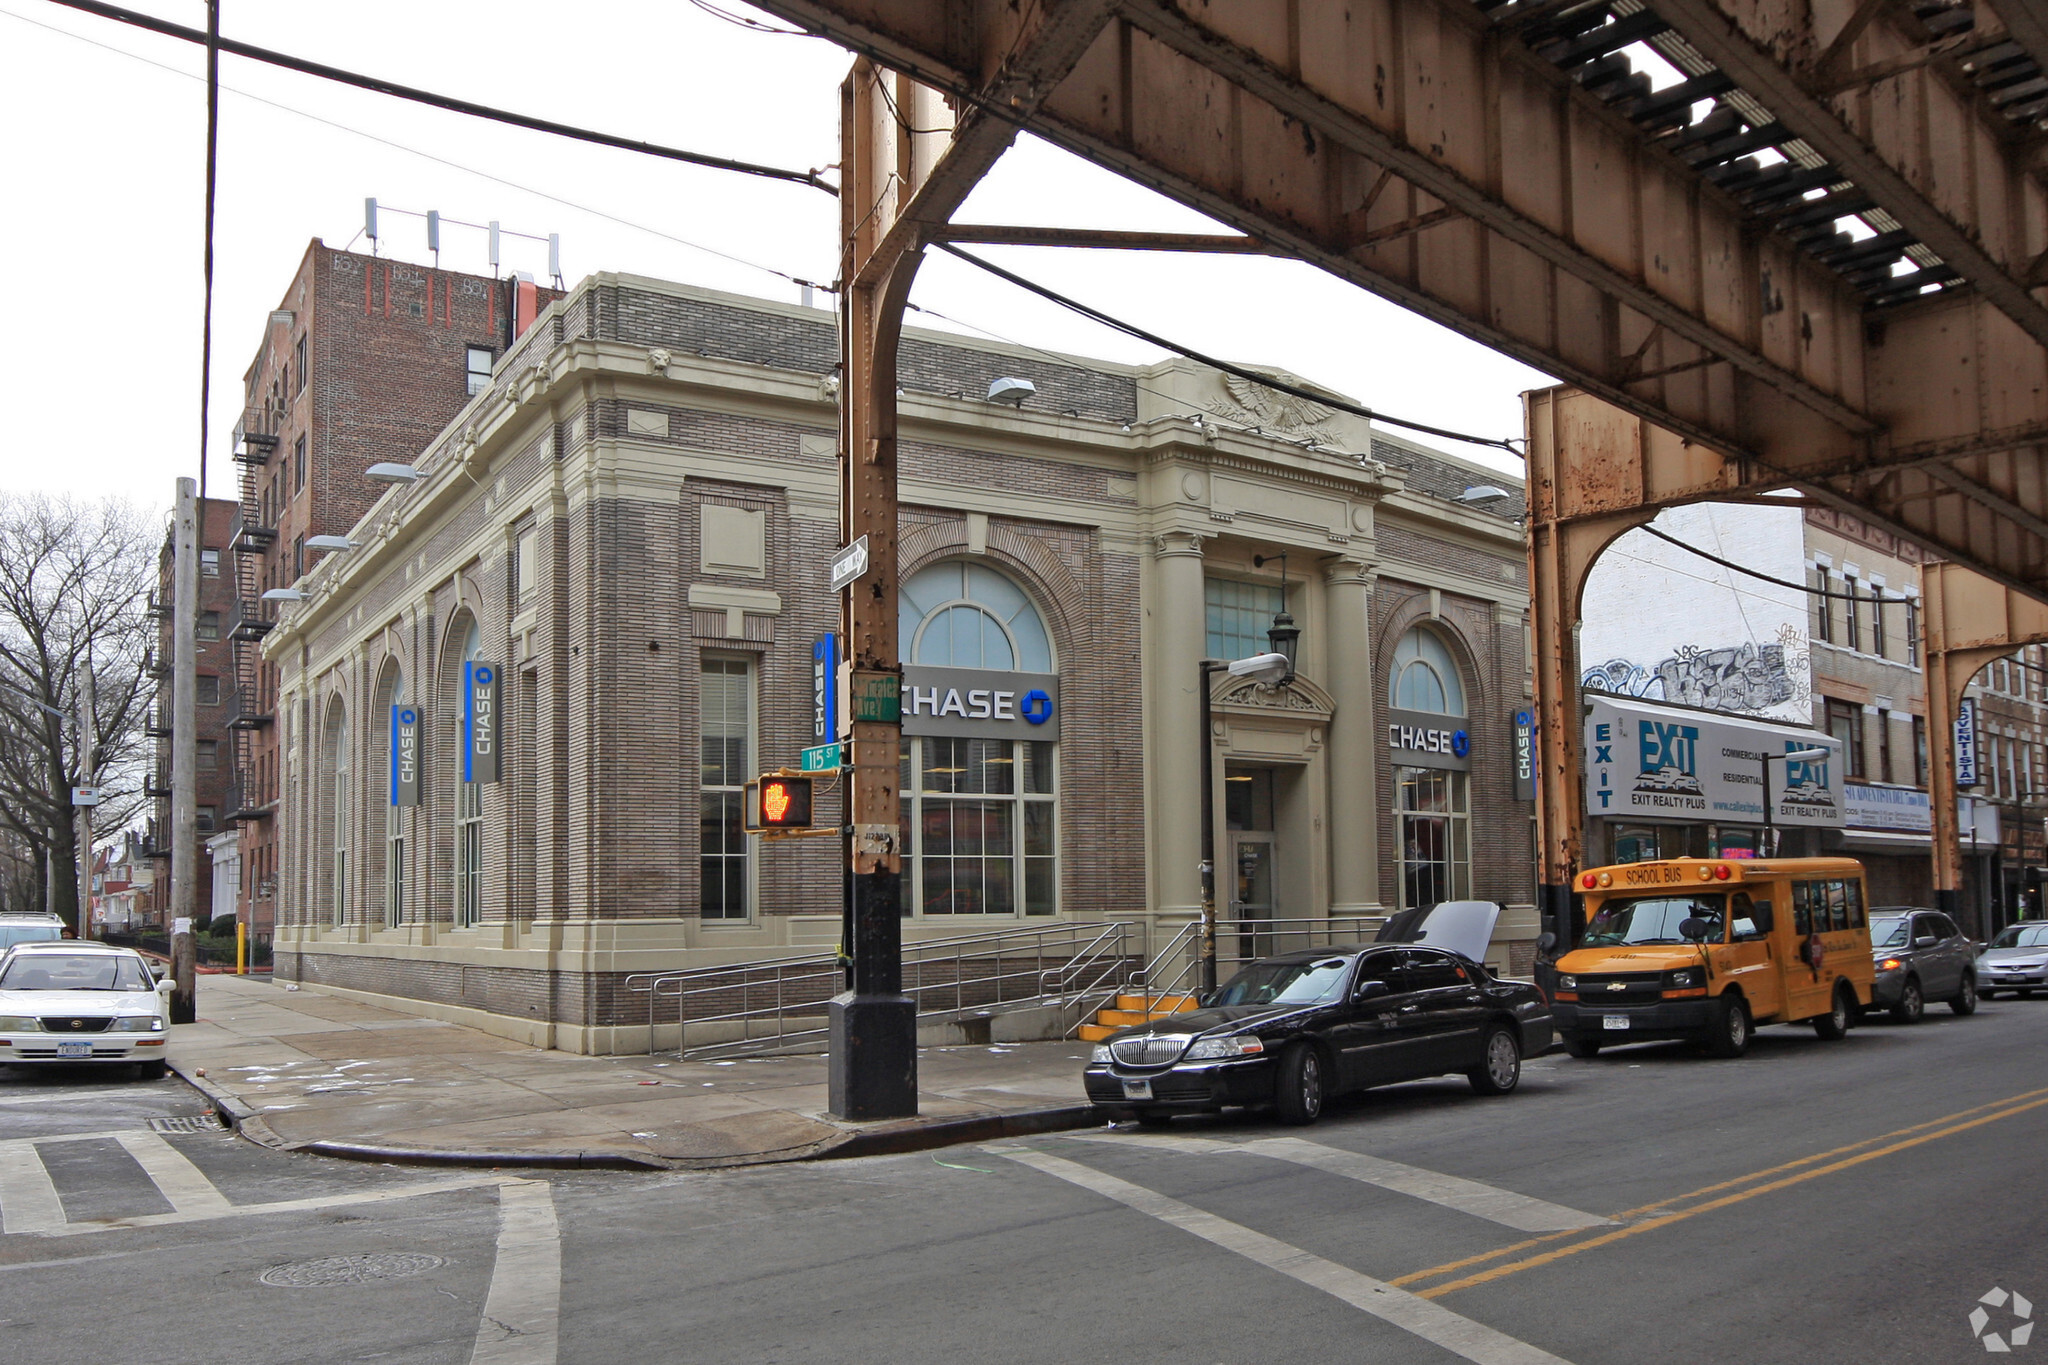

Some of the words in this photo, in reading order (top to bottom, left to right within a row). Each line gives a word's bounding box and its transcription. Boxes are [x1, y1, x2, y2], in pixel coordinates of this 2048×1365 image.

[815, 662, 824, 736] CHASE
[476, 687, 491, 754] CHASE
[1389, 724, 1451, 754] CHASE
[401, 727, 414, 782] CHASE
[809, 750, 824, 770] 115
[826, 747, 834, 758] ST
[1518, 727, 1530, 779] CHASE
[1721, 748, 1763, 761] COMMERCIAL
[1723, 773, 1763, 785] RESIDENTIAL
[1632, 794, 1651, 805] EXIT
[1653, 795, 1684, 808] REALTY
[1686, 798, 1706, 809] PLUS
[1781, 806, 1796, 816] EXIT
[1797, 807, 1821, 818] REALTY
[1822, 809, 1837, 819] PLUS
[1626, 870, 1661, 885] SCHOOL
[1664, 867, 1682, 883] BUS
